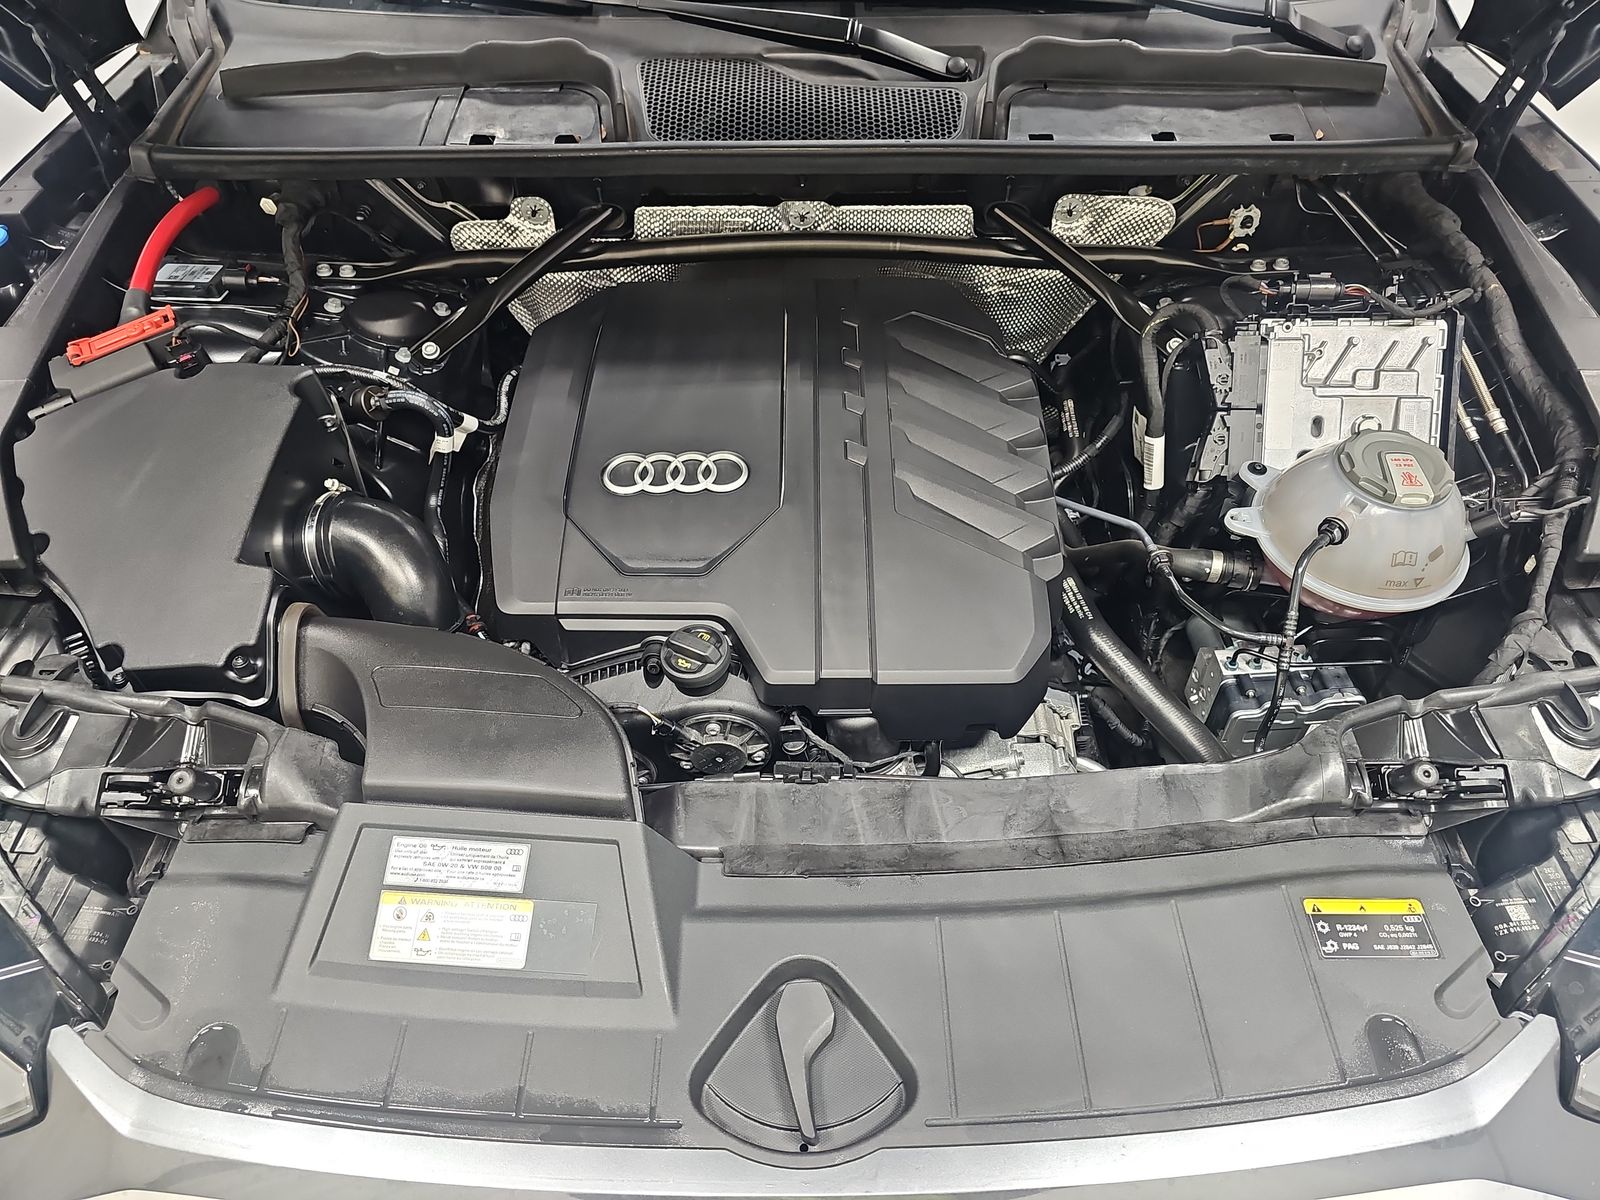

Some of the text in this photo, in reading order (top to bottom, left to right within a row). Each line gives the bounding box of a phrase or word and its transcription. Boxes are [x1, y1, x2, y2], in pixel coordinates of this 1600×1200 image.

[1385, 578, 1408, 588] max
[410, 898, 518, 912] WARNING ATTENTION
[1335, 924, 1416, 933] R-1234yf 0,525 kg
[1342, 942, 1360, 950] PAG
